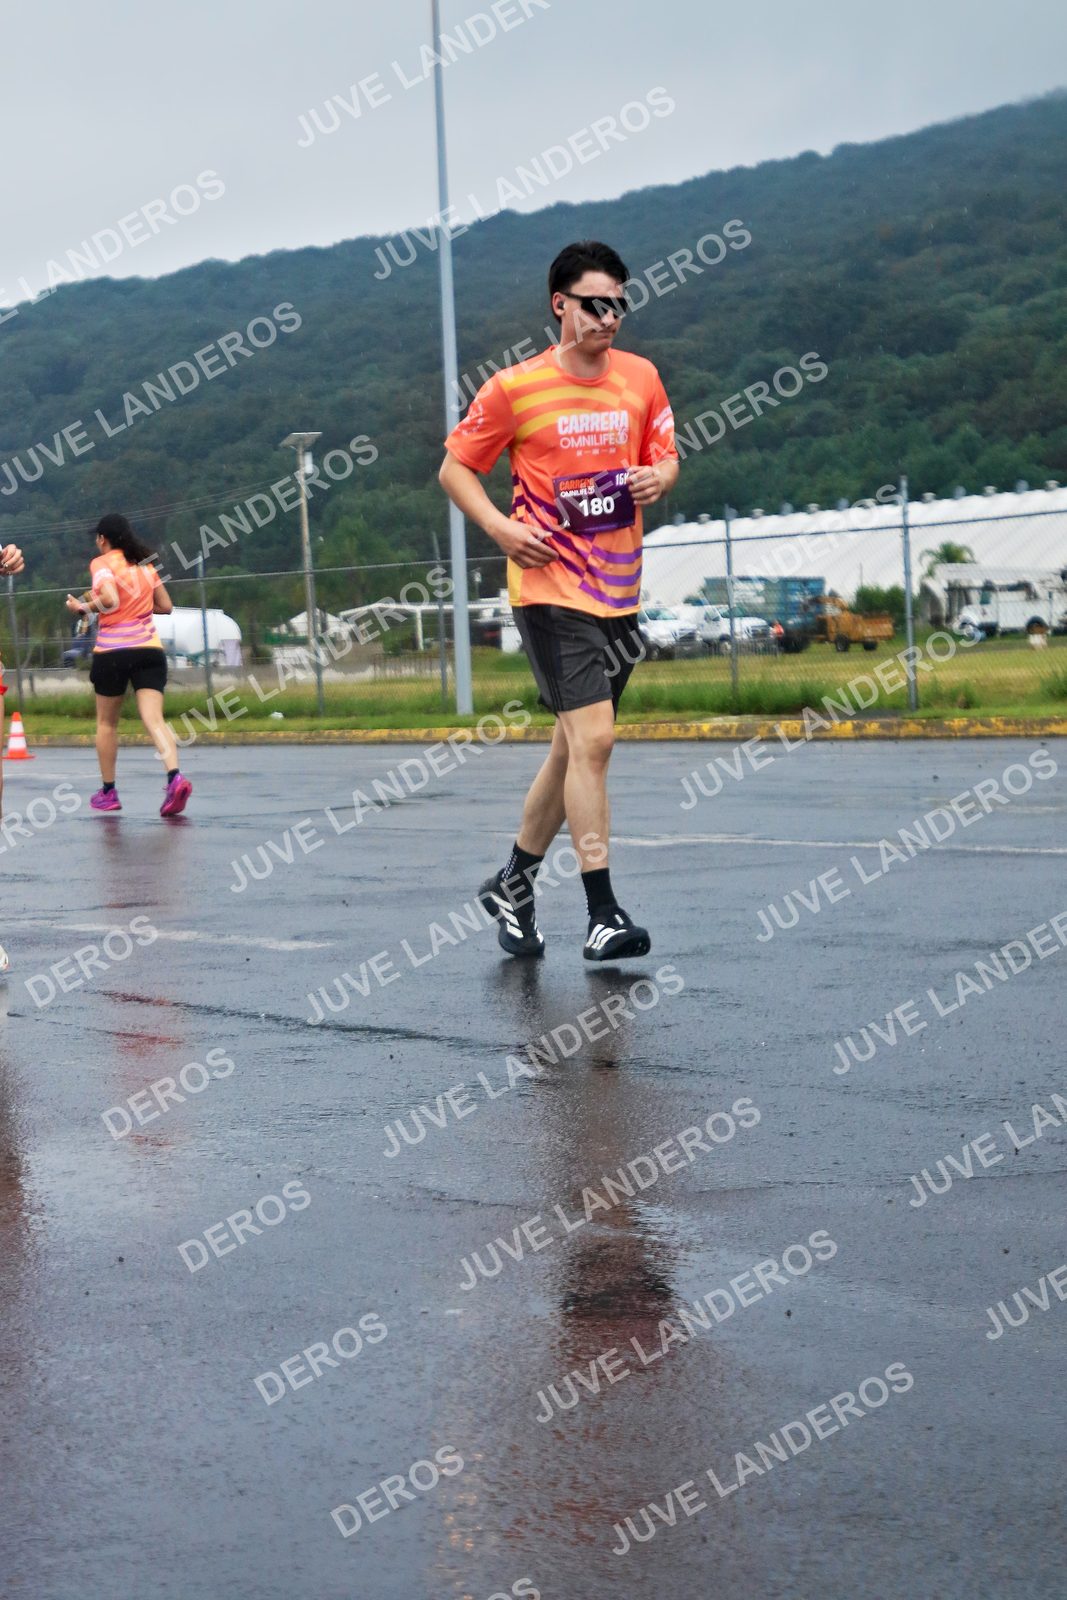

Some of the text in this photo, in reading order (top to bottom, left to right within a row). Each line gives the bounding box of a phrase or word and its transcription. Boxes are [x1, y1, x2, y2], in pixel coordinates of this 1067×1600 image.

[558, 410, 628, 434] CARRERA
[560, 432, 615, 449] OMNILIFE
[579, 496, 615, 517] 180
